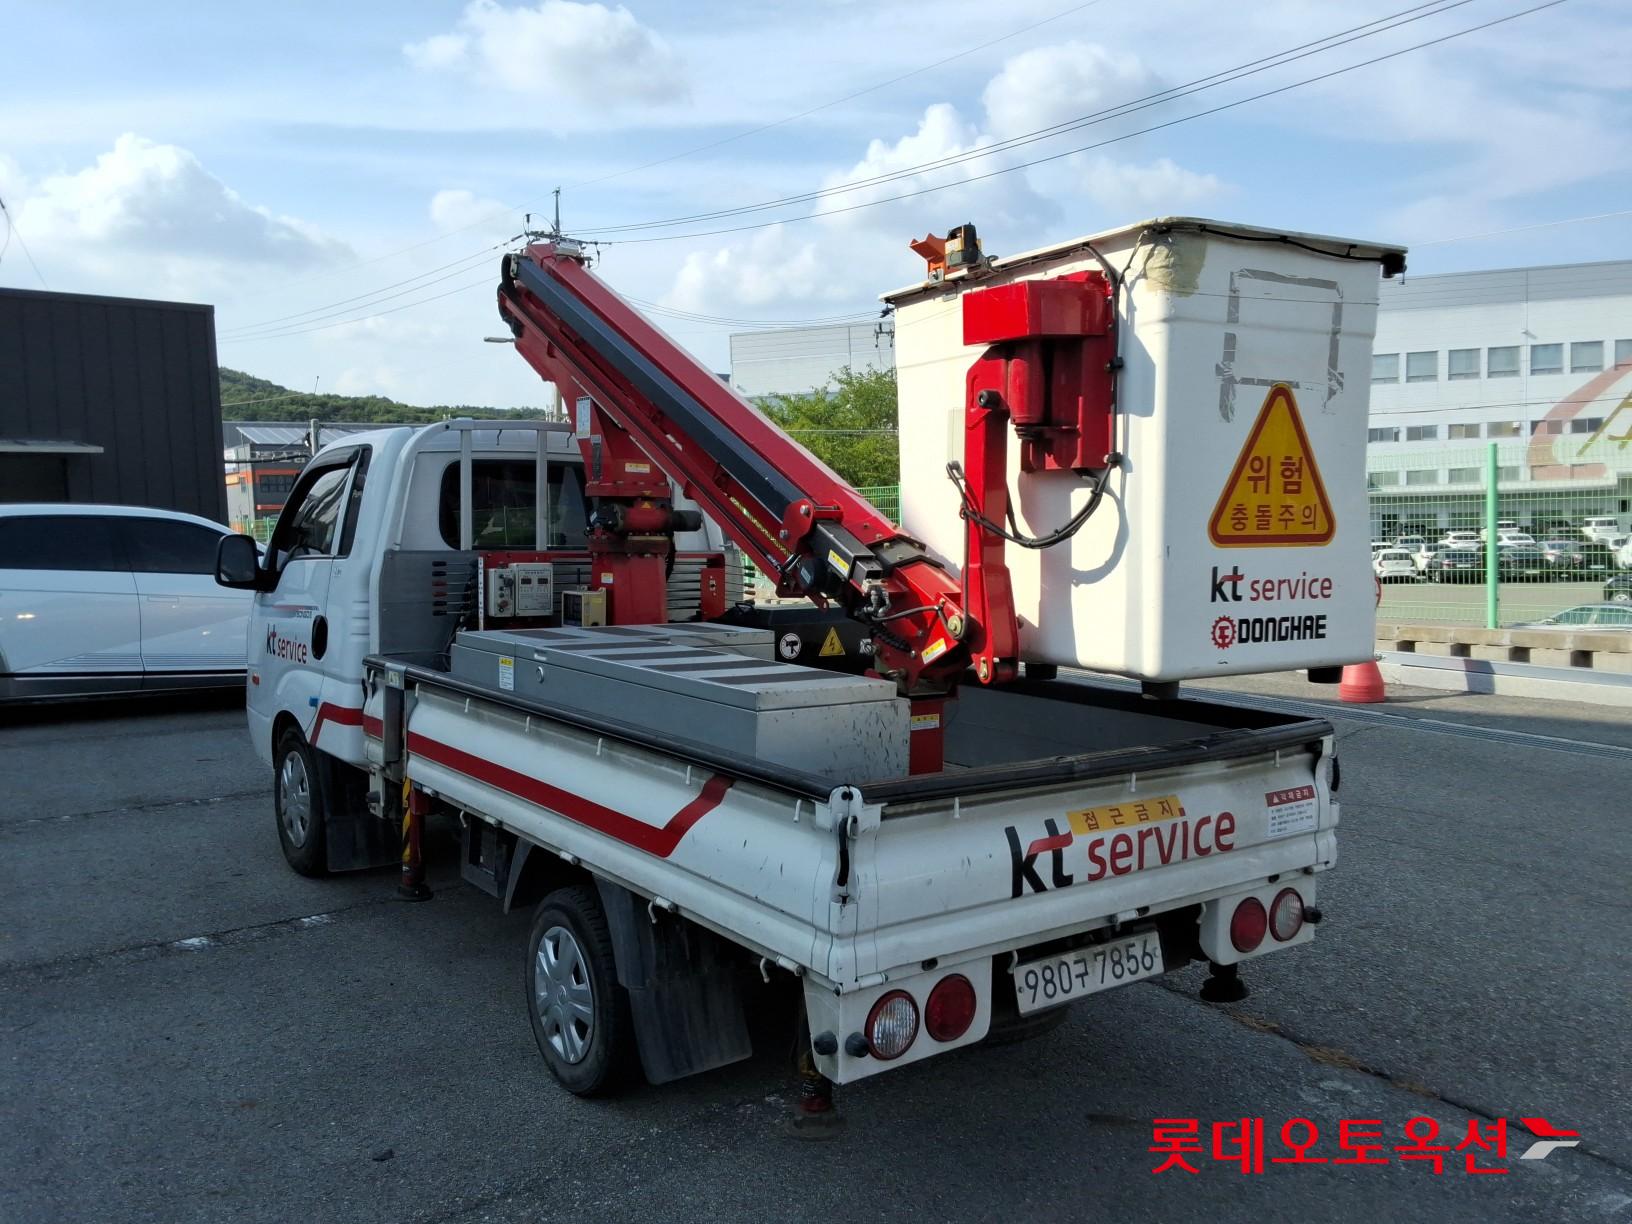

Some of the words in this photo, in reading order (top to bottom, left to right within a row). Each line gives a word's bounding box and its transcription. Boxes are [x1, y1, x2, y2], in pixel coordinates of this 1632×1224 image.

[1247, 455, 1303, 495] 위험
[1230, 503, 1317, 531] 충돌주의
[1211, 565, 1245, 603] kt
[1249, 571, 1333, 602] service
[266, 623, 277, 655] kt
[277, 634, 307, 665] service
[1237, 614, 1327, 644] DONGHAE
[1082, 799, 1174, 831] 접근금지
[1004, 818, 1074, 899] kt
[1087, 807, 1236, 882] service
